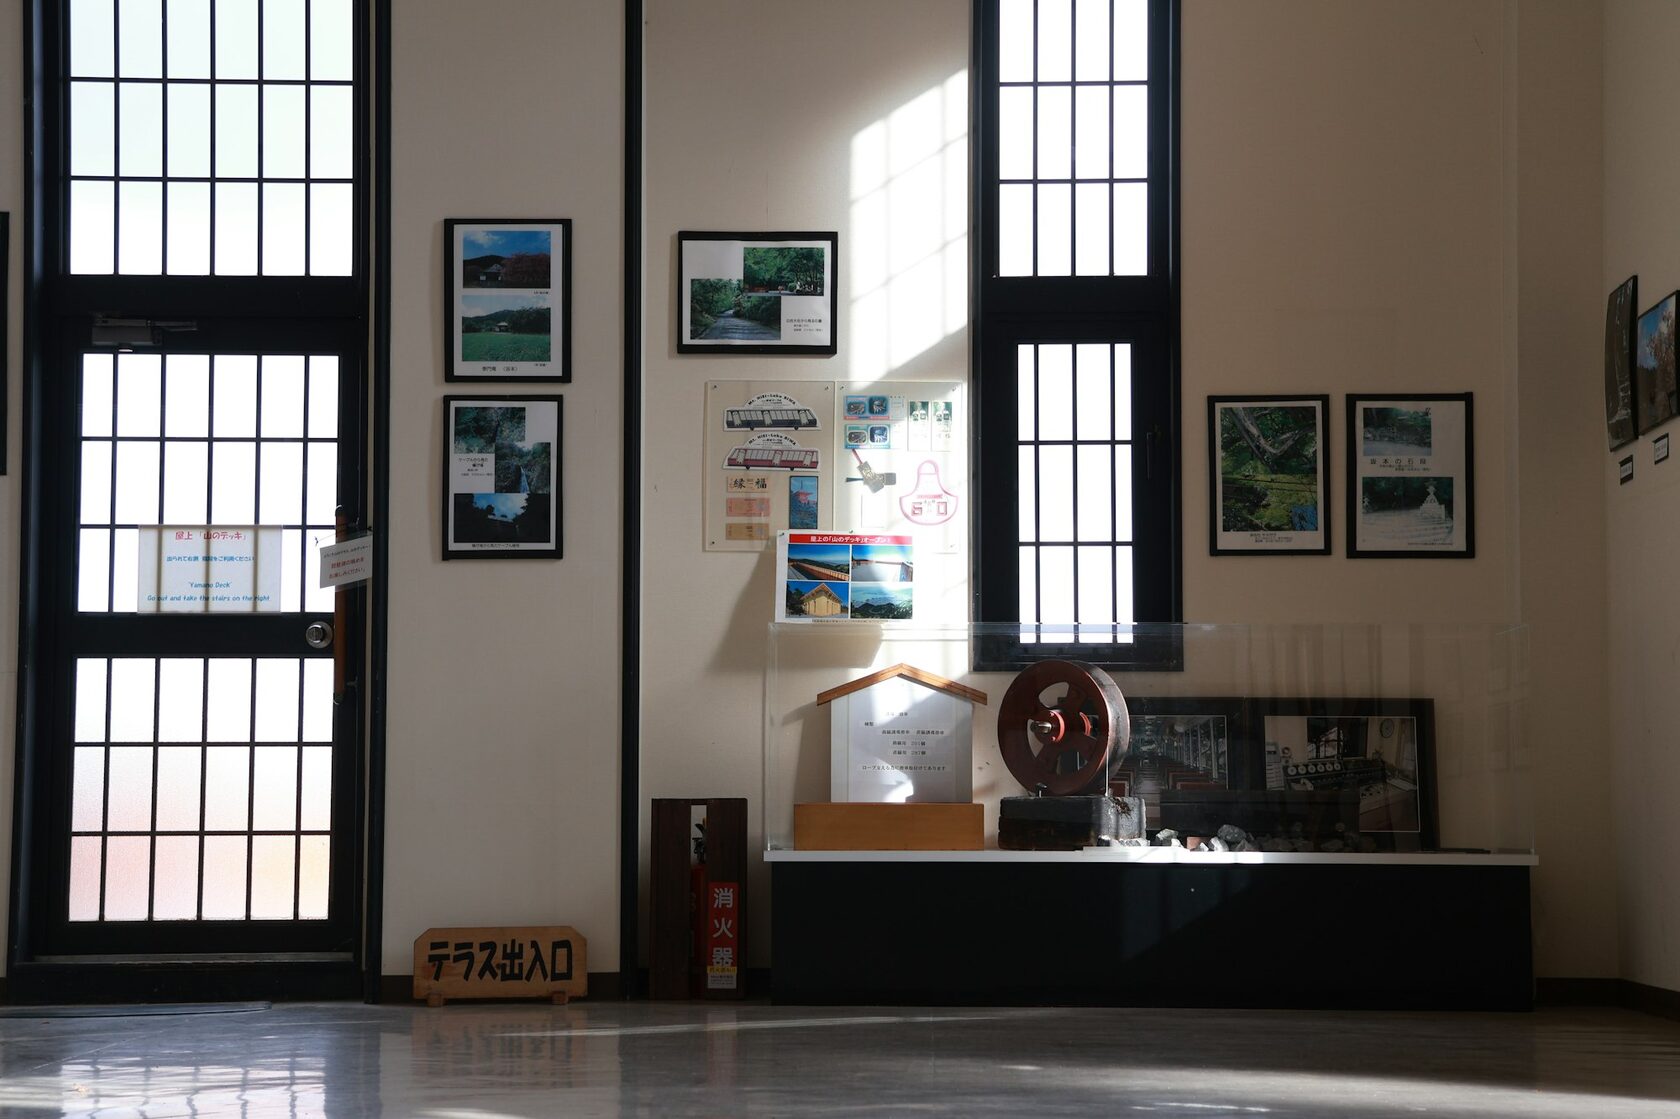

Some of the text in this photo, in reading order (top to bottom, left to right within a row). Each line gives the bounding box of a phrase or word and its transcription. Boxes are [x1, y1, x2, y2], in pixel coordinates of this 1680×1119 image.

[713, 887, 734, 967] 消火器
[428, 939, 573, 982] テラス出入口
